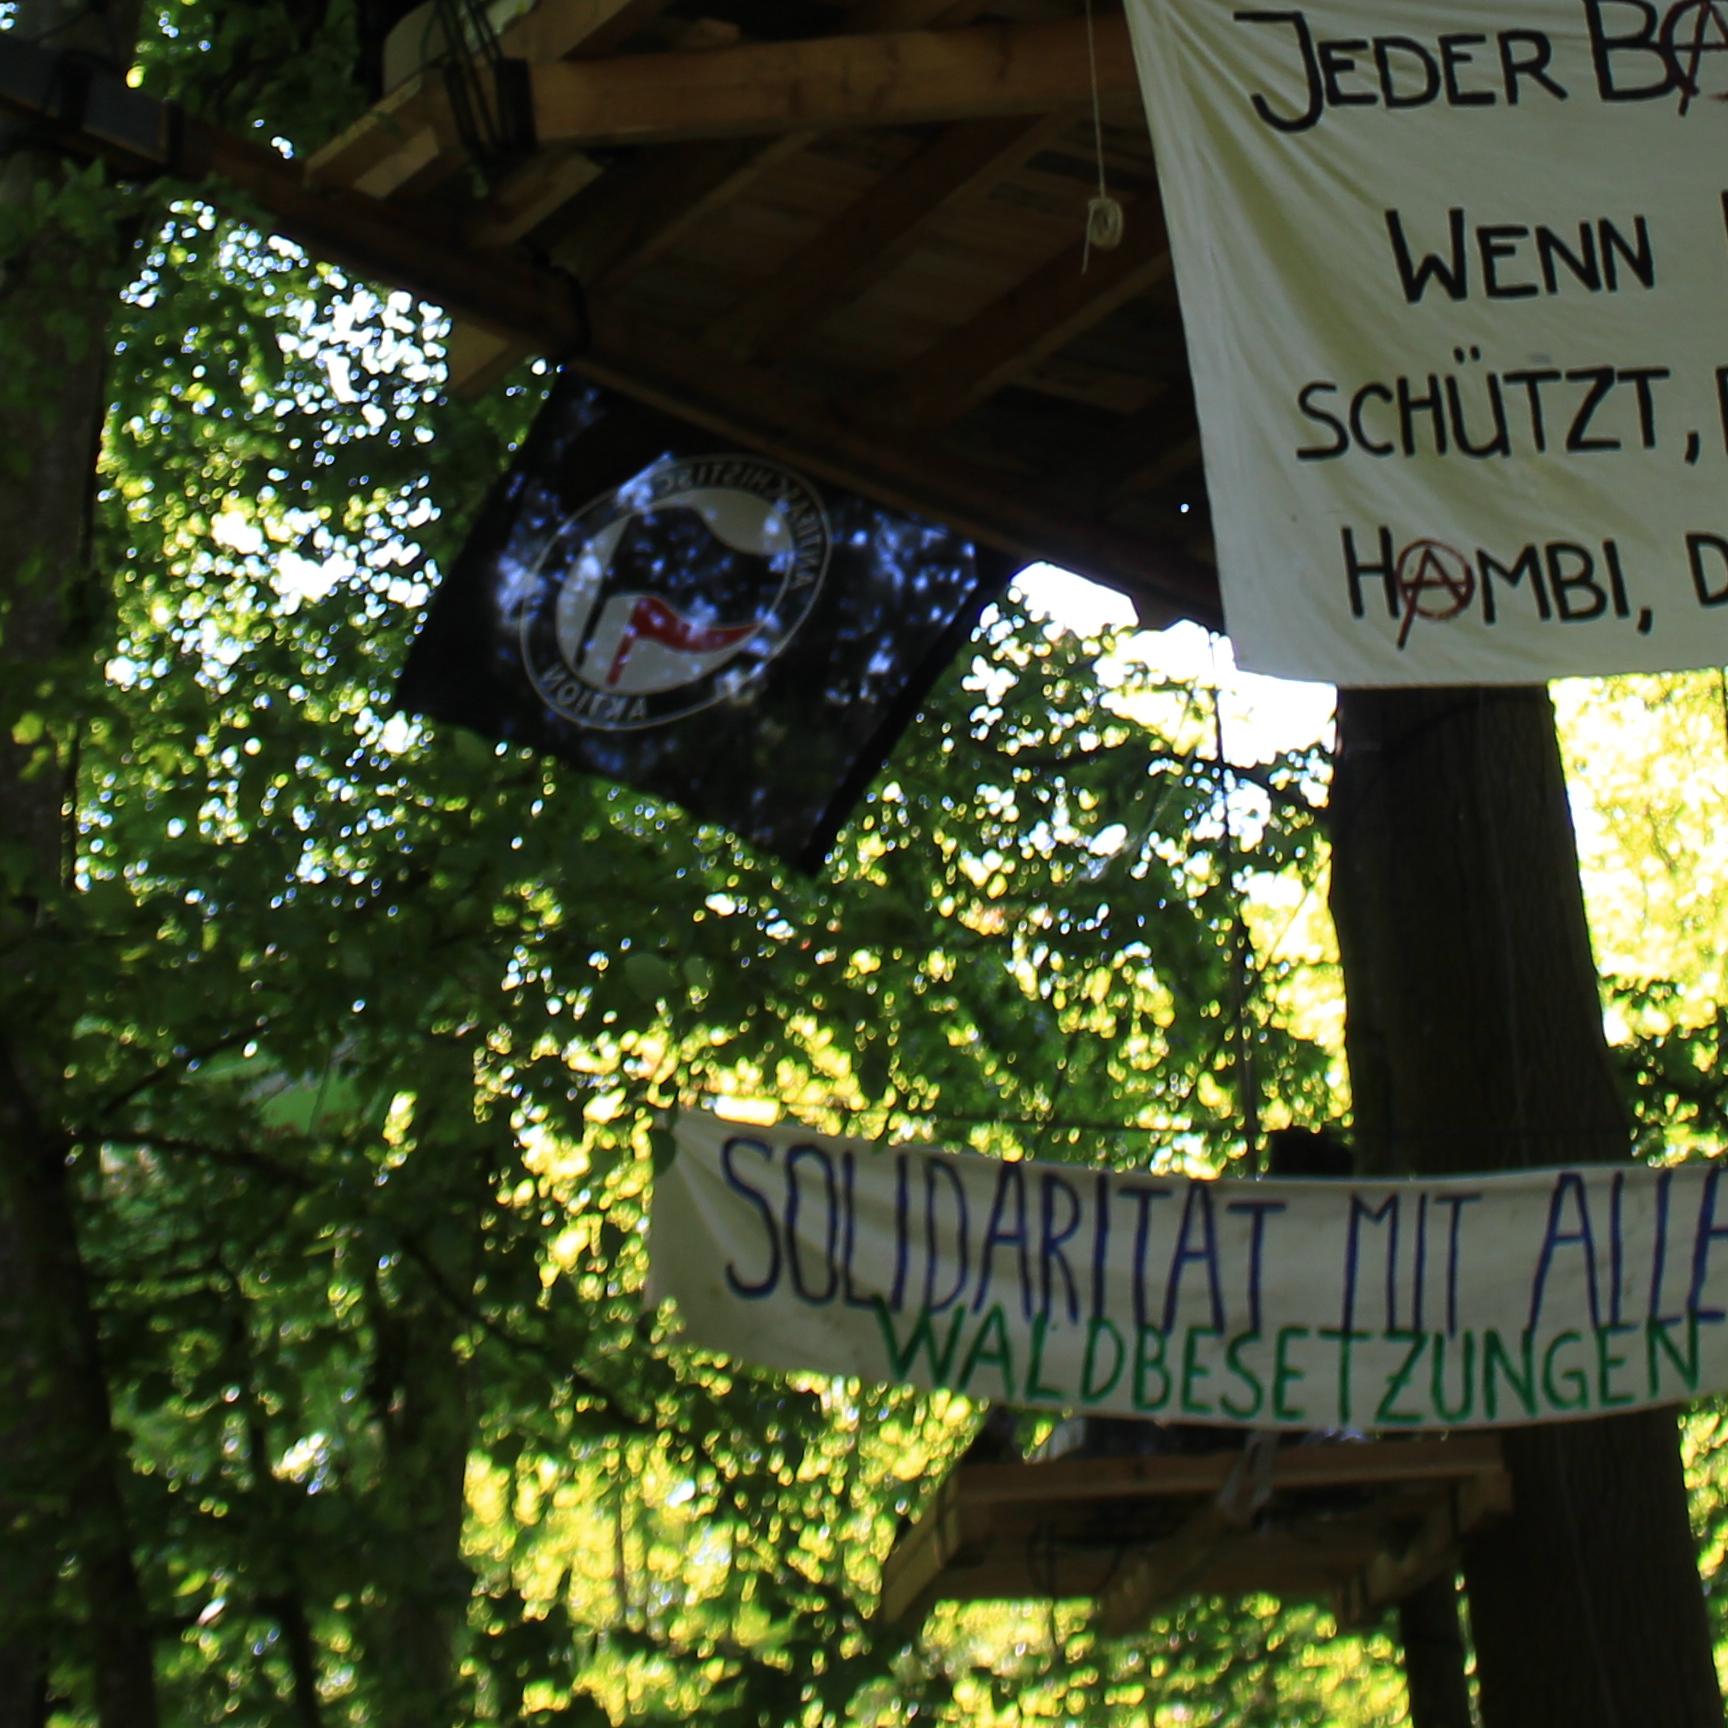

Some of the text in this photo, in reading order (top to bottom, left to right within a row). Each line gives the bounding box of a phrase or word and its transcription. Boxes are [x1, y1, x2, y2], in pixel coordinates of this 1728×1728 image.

[1232, 10, 1569, 133] JEDER
[1384, 206, 1654, 306] WENN
[1296, 349, 1702, 467] SCHÜTZT,
[1338, 524, 1654, 652] HAMBI,
[1340, 1191, 1482, 1339] MIT
[872, 1292, 1716, 1428] WALDBESETZUNGEN
